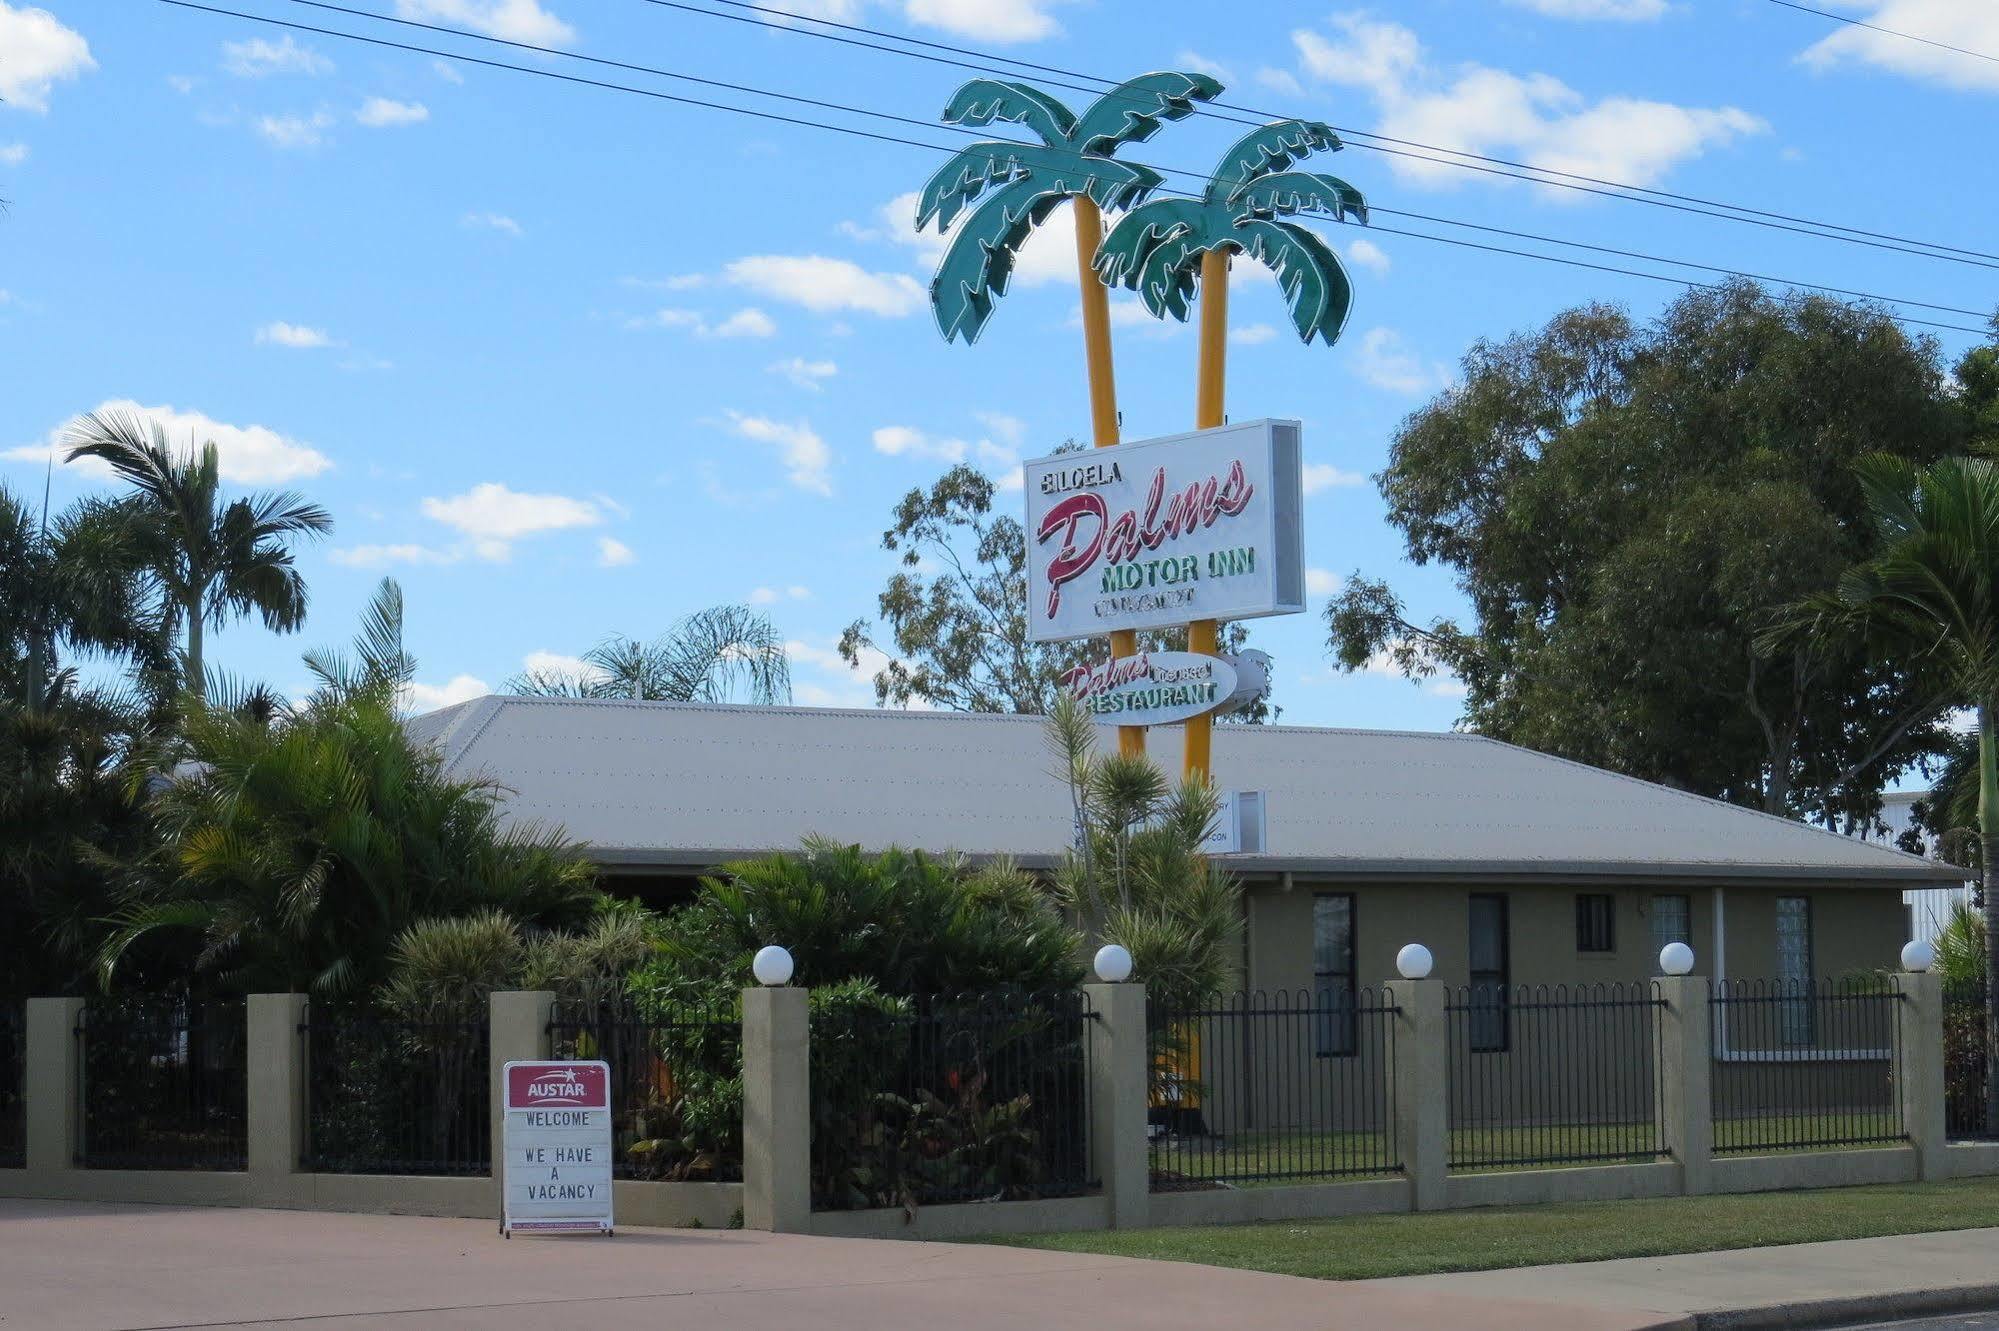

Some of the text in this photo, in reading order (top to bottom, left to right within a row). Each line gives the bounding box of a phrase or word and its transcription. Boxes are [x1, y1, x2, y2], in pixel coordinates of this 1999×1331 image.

[1040, 462, 1122, 494] BILOELA
[1037, 459, 1255, 619] Palms
[1100, 547, 1255, 593] MOTOR INN
[1058, 655, 1148, 701] Palms
[1085, 682, 1218, 714] RESTAURANT
[528, 1083, 585, 1097] AUSTAR
[526, 1112, 590, 1126] WELCOME
[525, 1148, 593, 1162] WE HAVE
[551, 1167, 559, 1181] A
[528, 1184, 595, 1200] VACANCY
